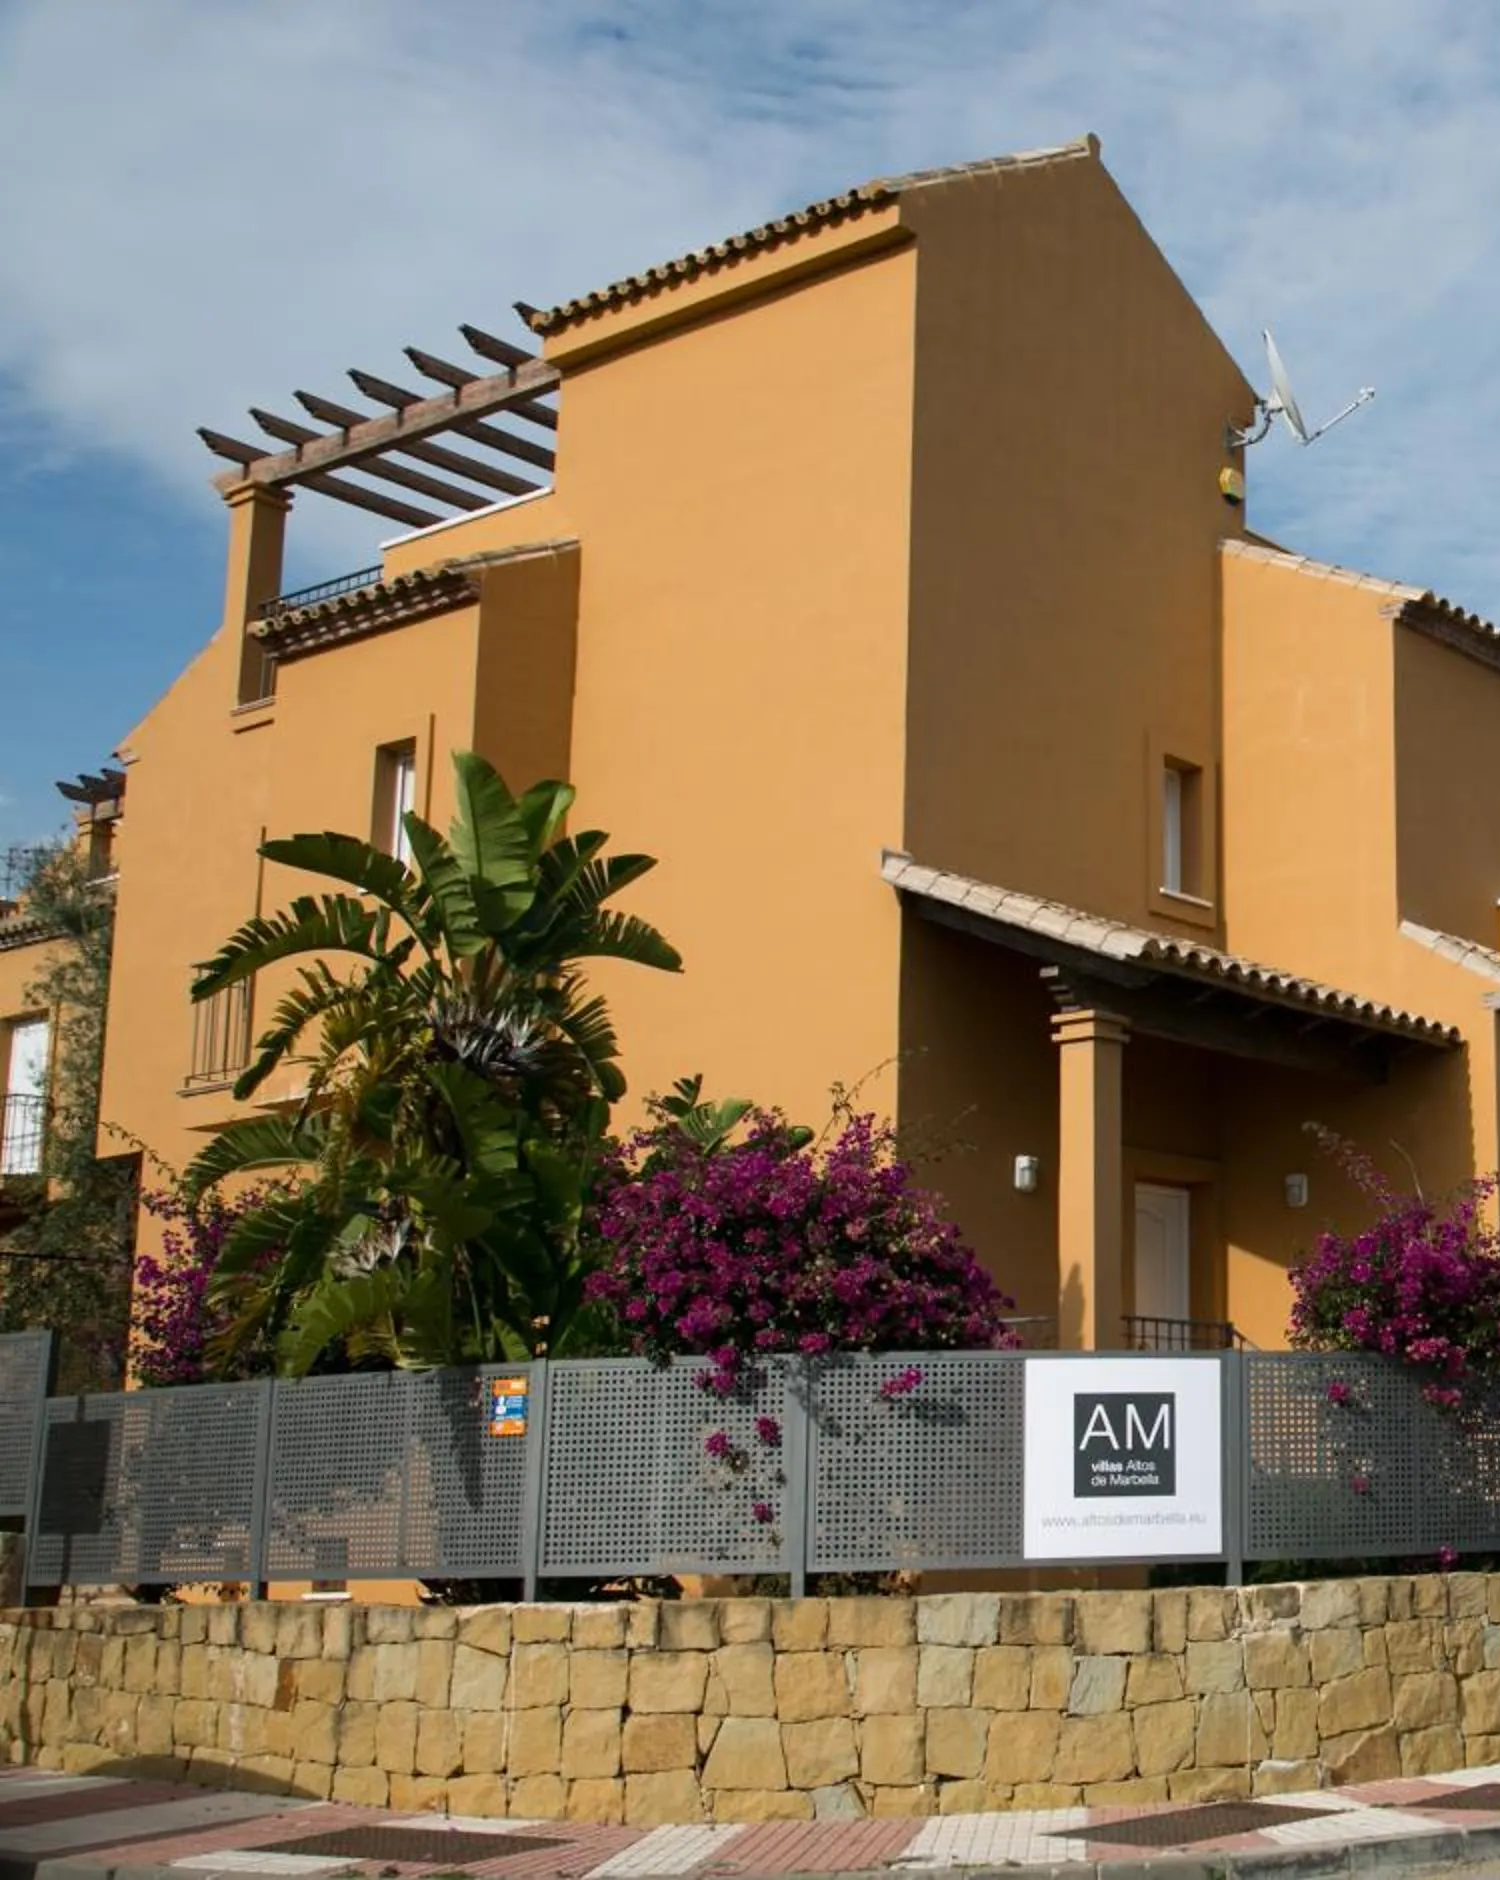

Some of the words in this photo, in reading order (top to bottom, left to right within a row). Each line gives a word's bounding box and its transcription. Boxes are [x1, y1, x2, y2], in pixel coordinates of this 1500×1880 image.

[1080, 1403, 1170, 1450] AM
[1091, 1460, 1123, 1472] villas
[1126, 1460, 1156, 1471] Altos
[1091, 1475, 1107, 1486] de
[1109, 1474, 1159, 1486] Marbella
